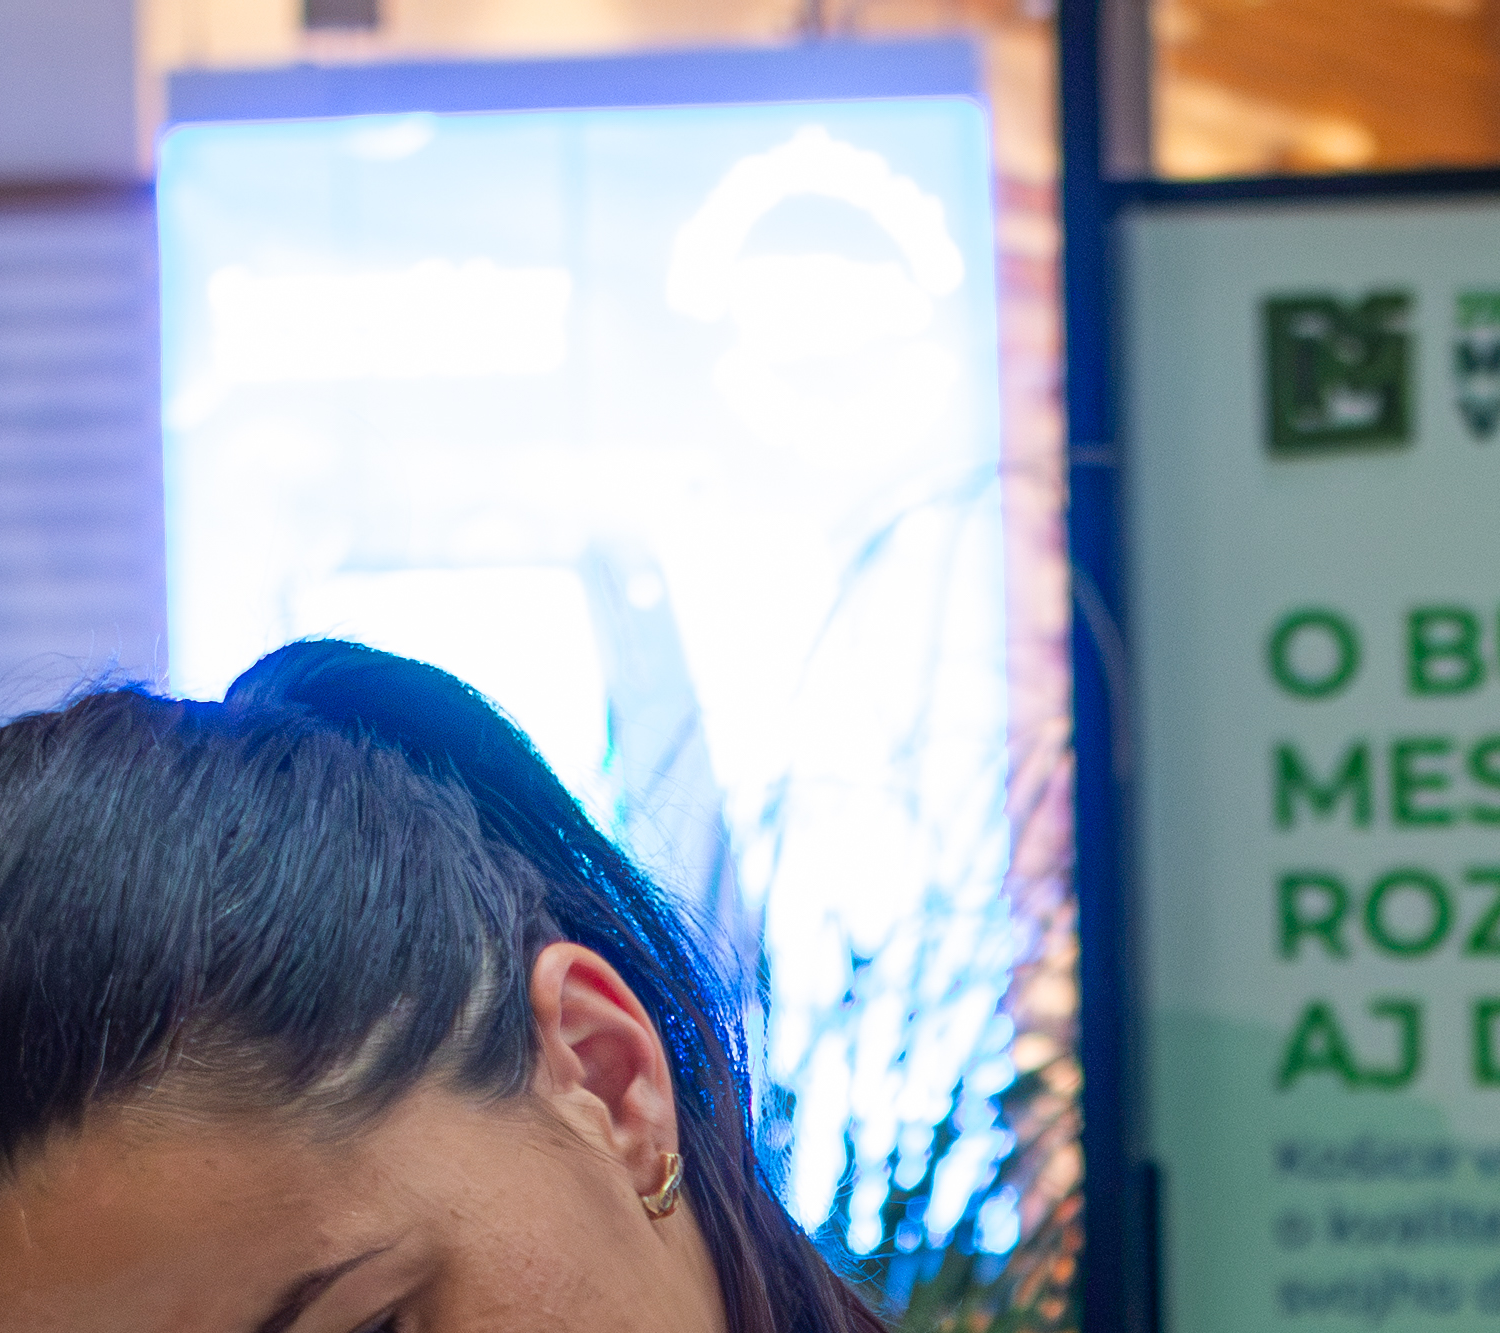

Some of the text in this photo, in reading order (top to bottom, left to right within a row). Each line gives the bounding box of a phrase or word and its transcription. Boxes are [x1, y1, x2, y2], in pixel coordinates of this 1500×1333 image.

[1267, 607, 1364, 702] O
[1276, 998, 1425, 1090] AJ
[1274, 1131, 1452, 1181] Košice
[1275, 1210, 1311, 1250] o
